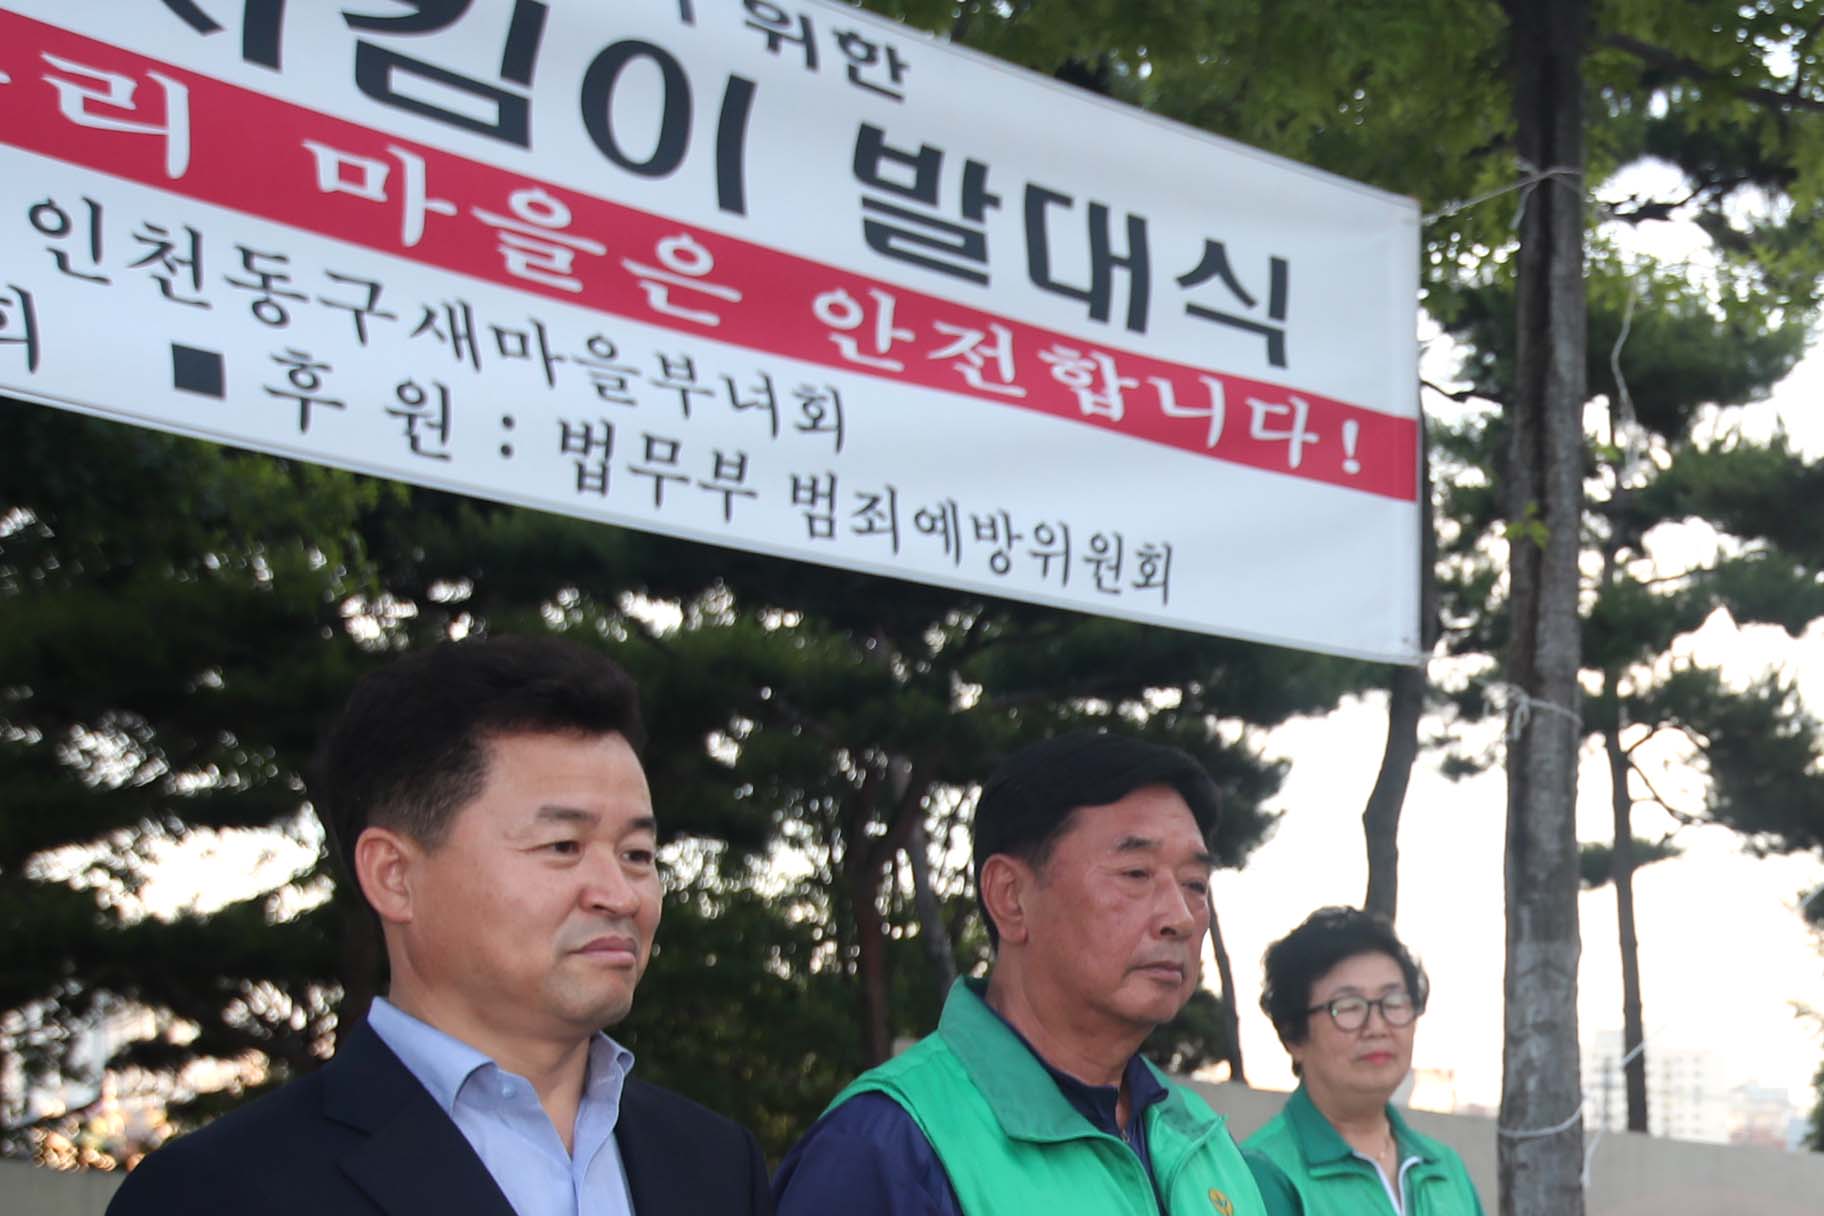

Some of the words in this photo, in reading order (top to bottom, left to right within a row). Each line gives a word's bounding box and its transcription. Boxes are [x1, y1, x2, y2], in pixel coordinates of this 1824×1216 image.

[743, 0, 909, 103] 위한
[0, 50, 190, 180] 리
[302, 138, 743, 327] 마을은
[812, 288, 1363, 475] 안전합니다!
[852, 122, 1291, 369] 발대식
[557, 416, 758, 522] 법무부
[788, 472, 1175, 607] 범죄예방위원회
